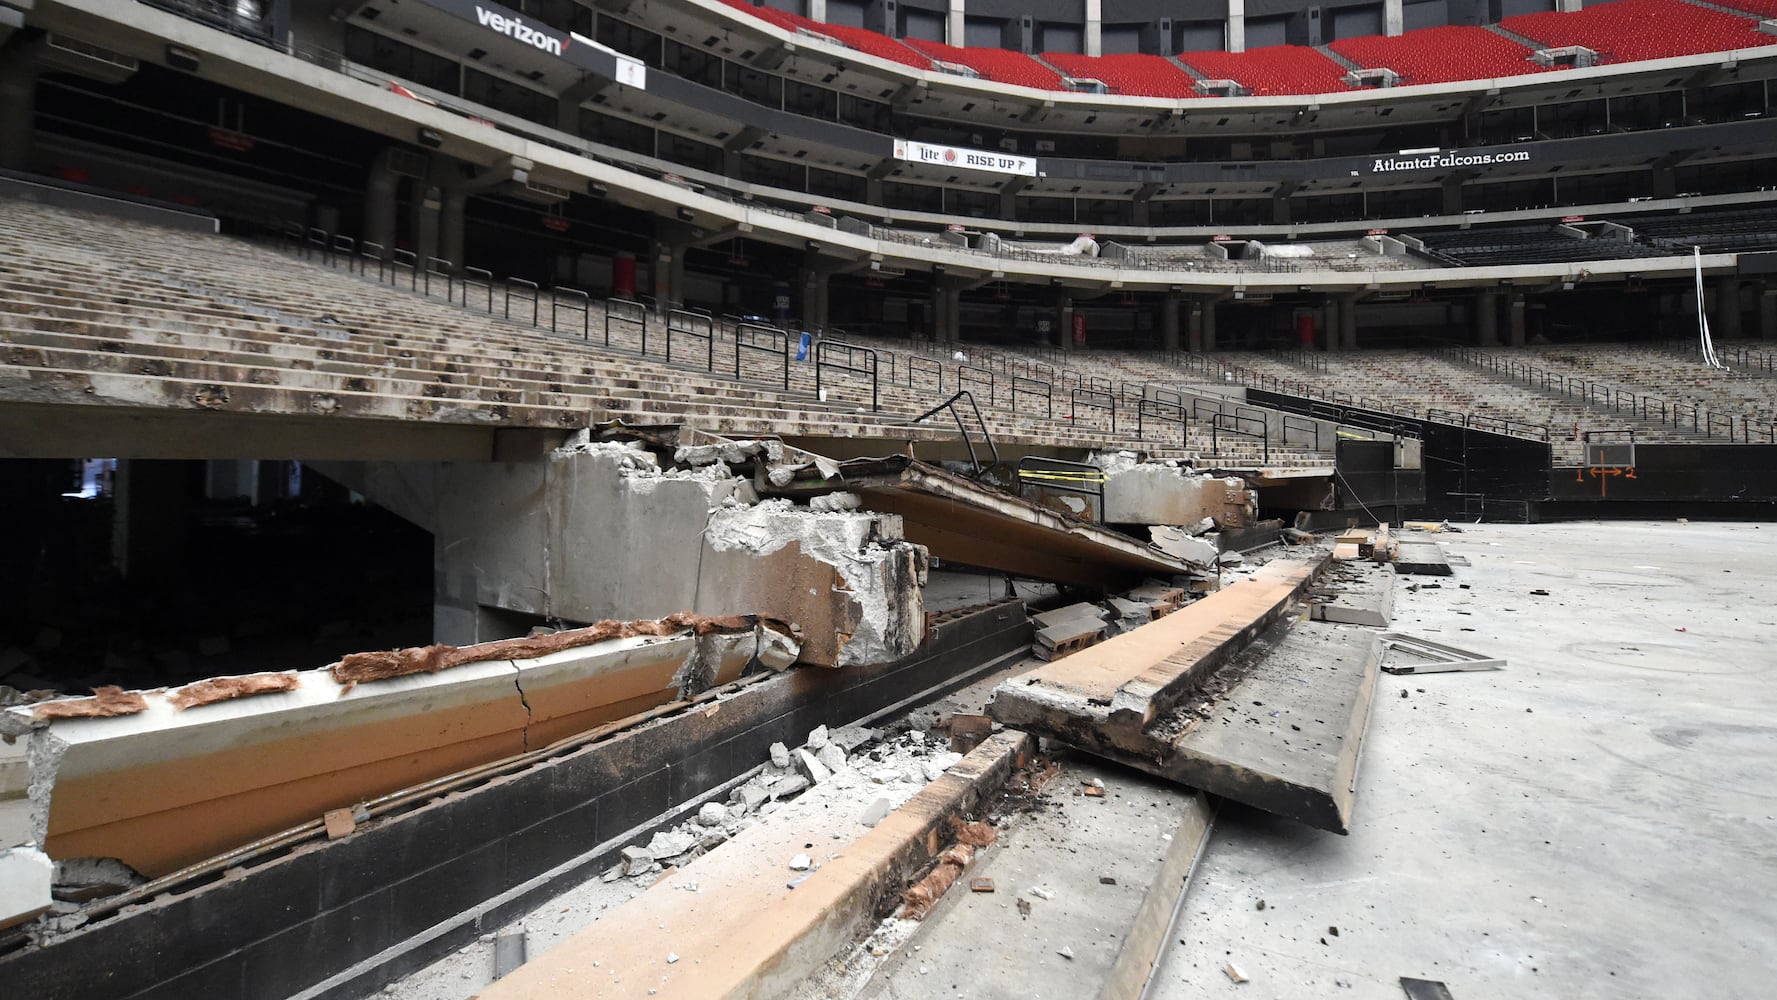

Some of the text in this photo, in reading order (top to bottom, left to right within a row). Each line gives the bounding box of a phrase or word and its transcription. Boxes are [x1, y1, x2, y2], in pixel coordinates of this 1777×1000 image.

[475, 5, 561, 56] verizon
[920, 147, 939, 162] Lite
[966, 154, 1015, 169] RISE UP
[1372, 150, 1530, 172] AtlantaFalcons.com
[1625, 466, 1637, 479] 2
